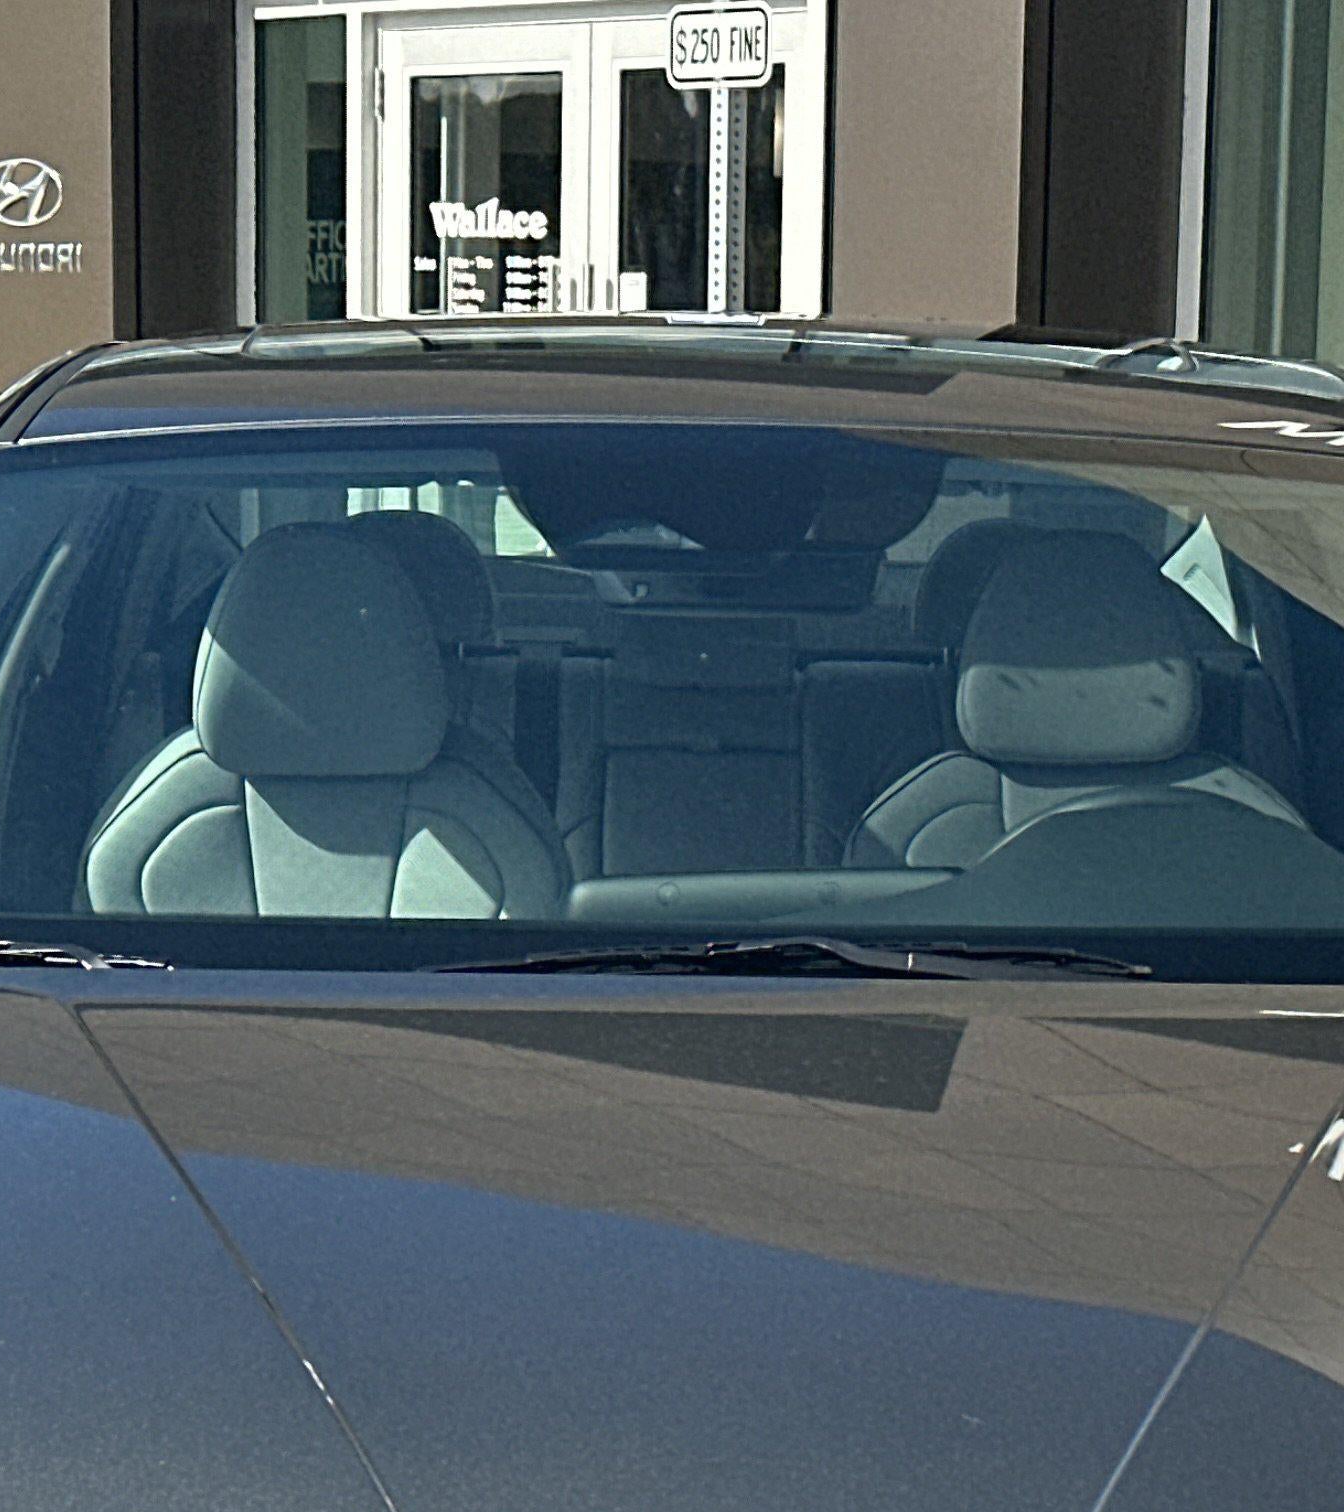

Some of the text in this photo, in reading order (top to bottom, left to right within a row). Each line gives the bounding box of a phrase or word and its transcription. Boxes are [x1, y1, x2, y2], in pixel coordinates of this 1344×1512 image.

[675, 26, 762, 68] $250 FINE
[429, 197, 548, 239] Wallace
